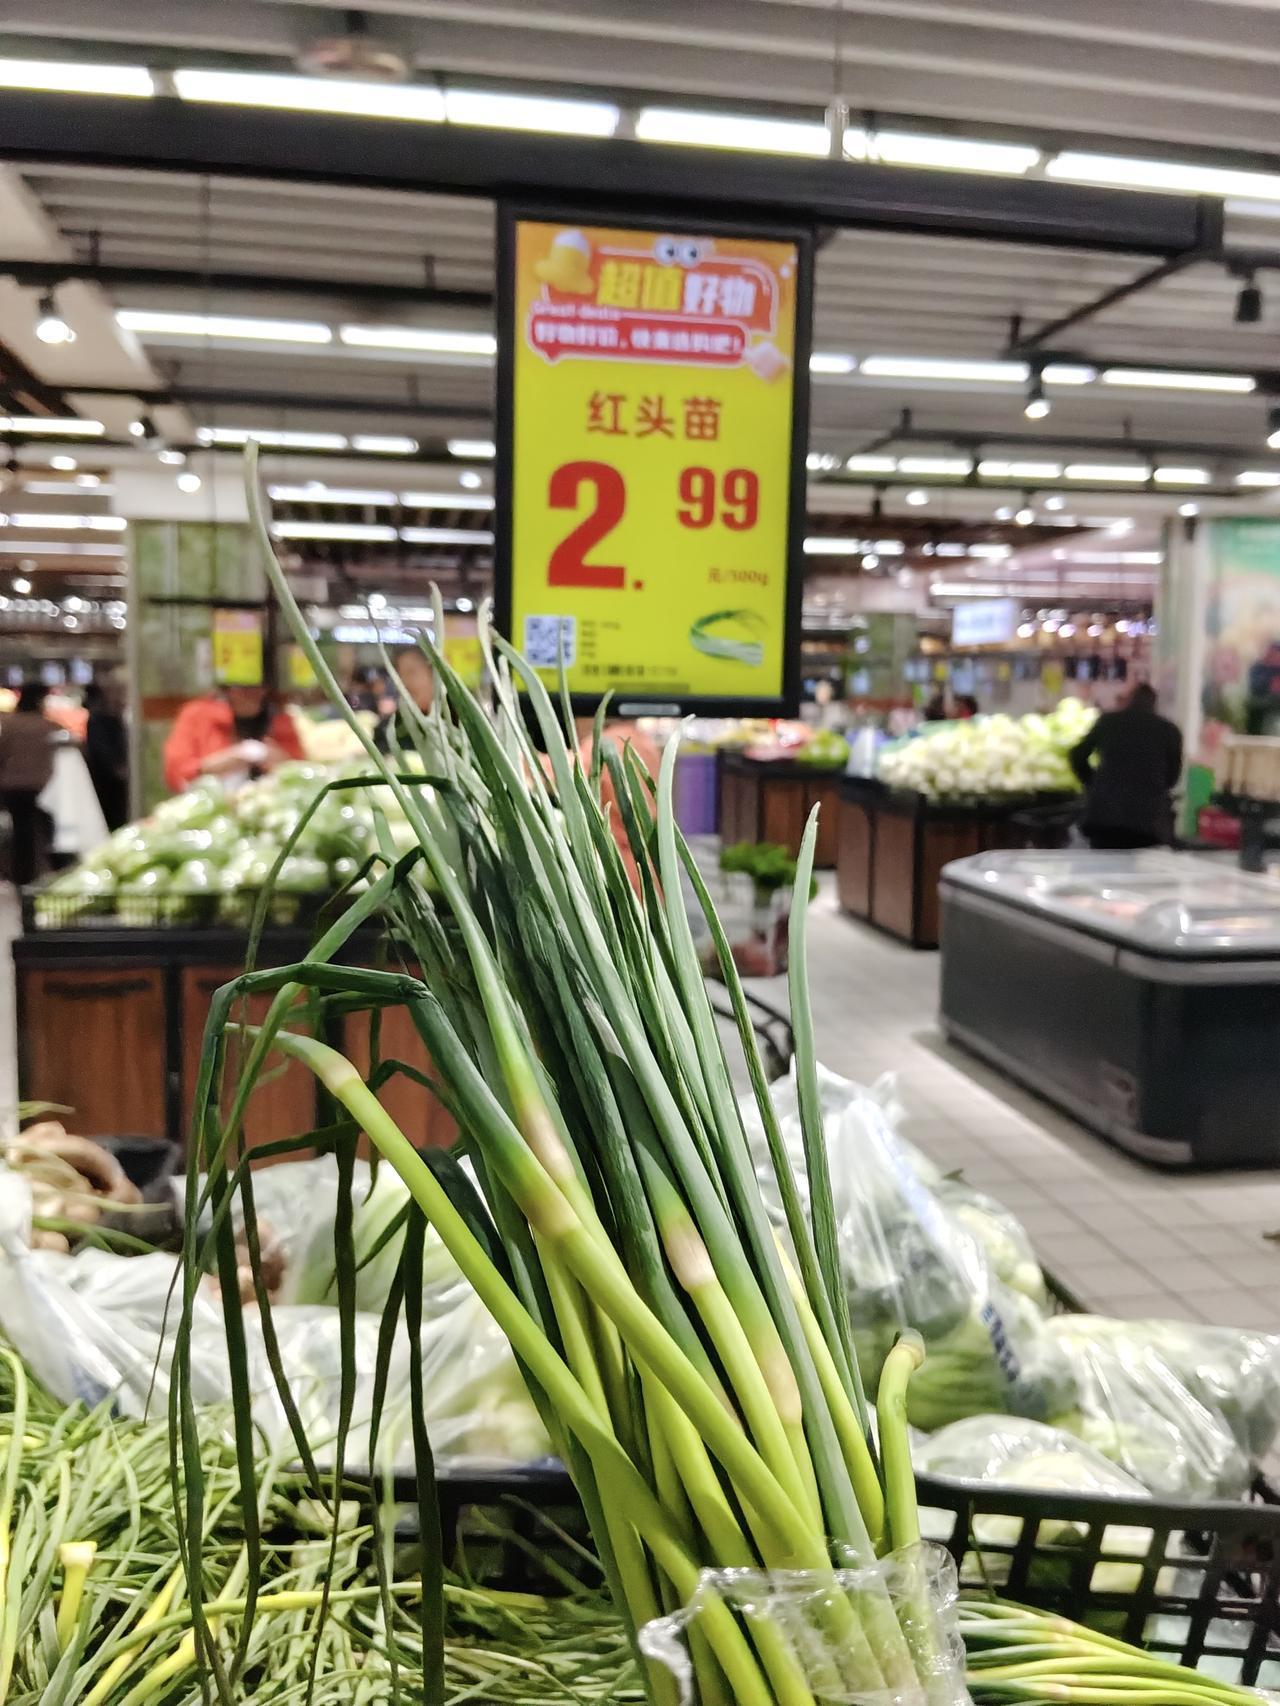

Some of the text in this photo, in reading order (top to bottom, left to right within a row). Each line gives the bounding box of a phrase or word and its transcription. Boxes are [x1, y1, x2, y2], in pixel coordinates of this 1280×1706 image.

[596, 260, 757, 318] 超值好物
[587, 391, 722, 441] 红头苗
[677, 465, 760, 532] 99
